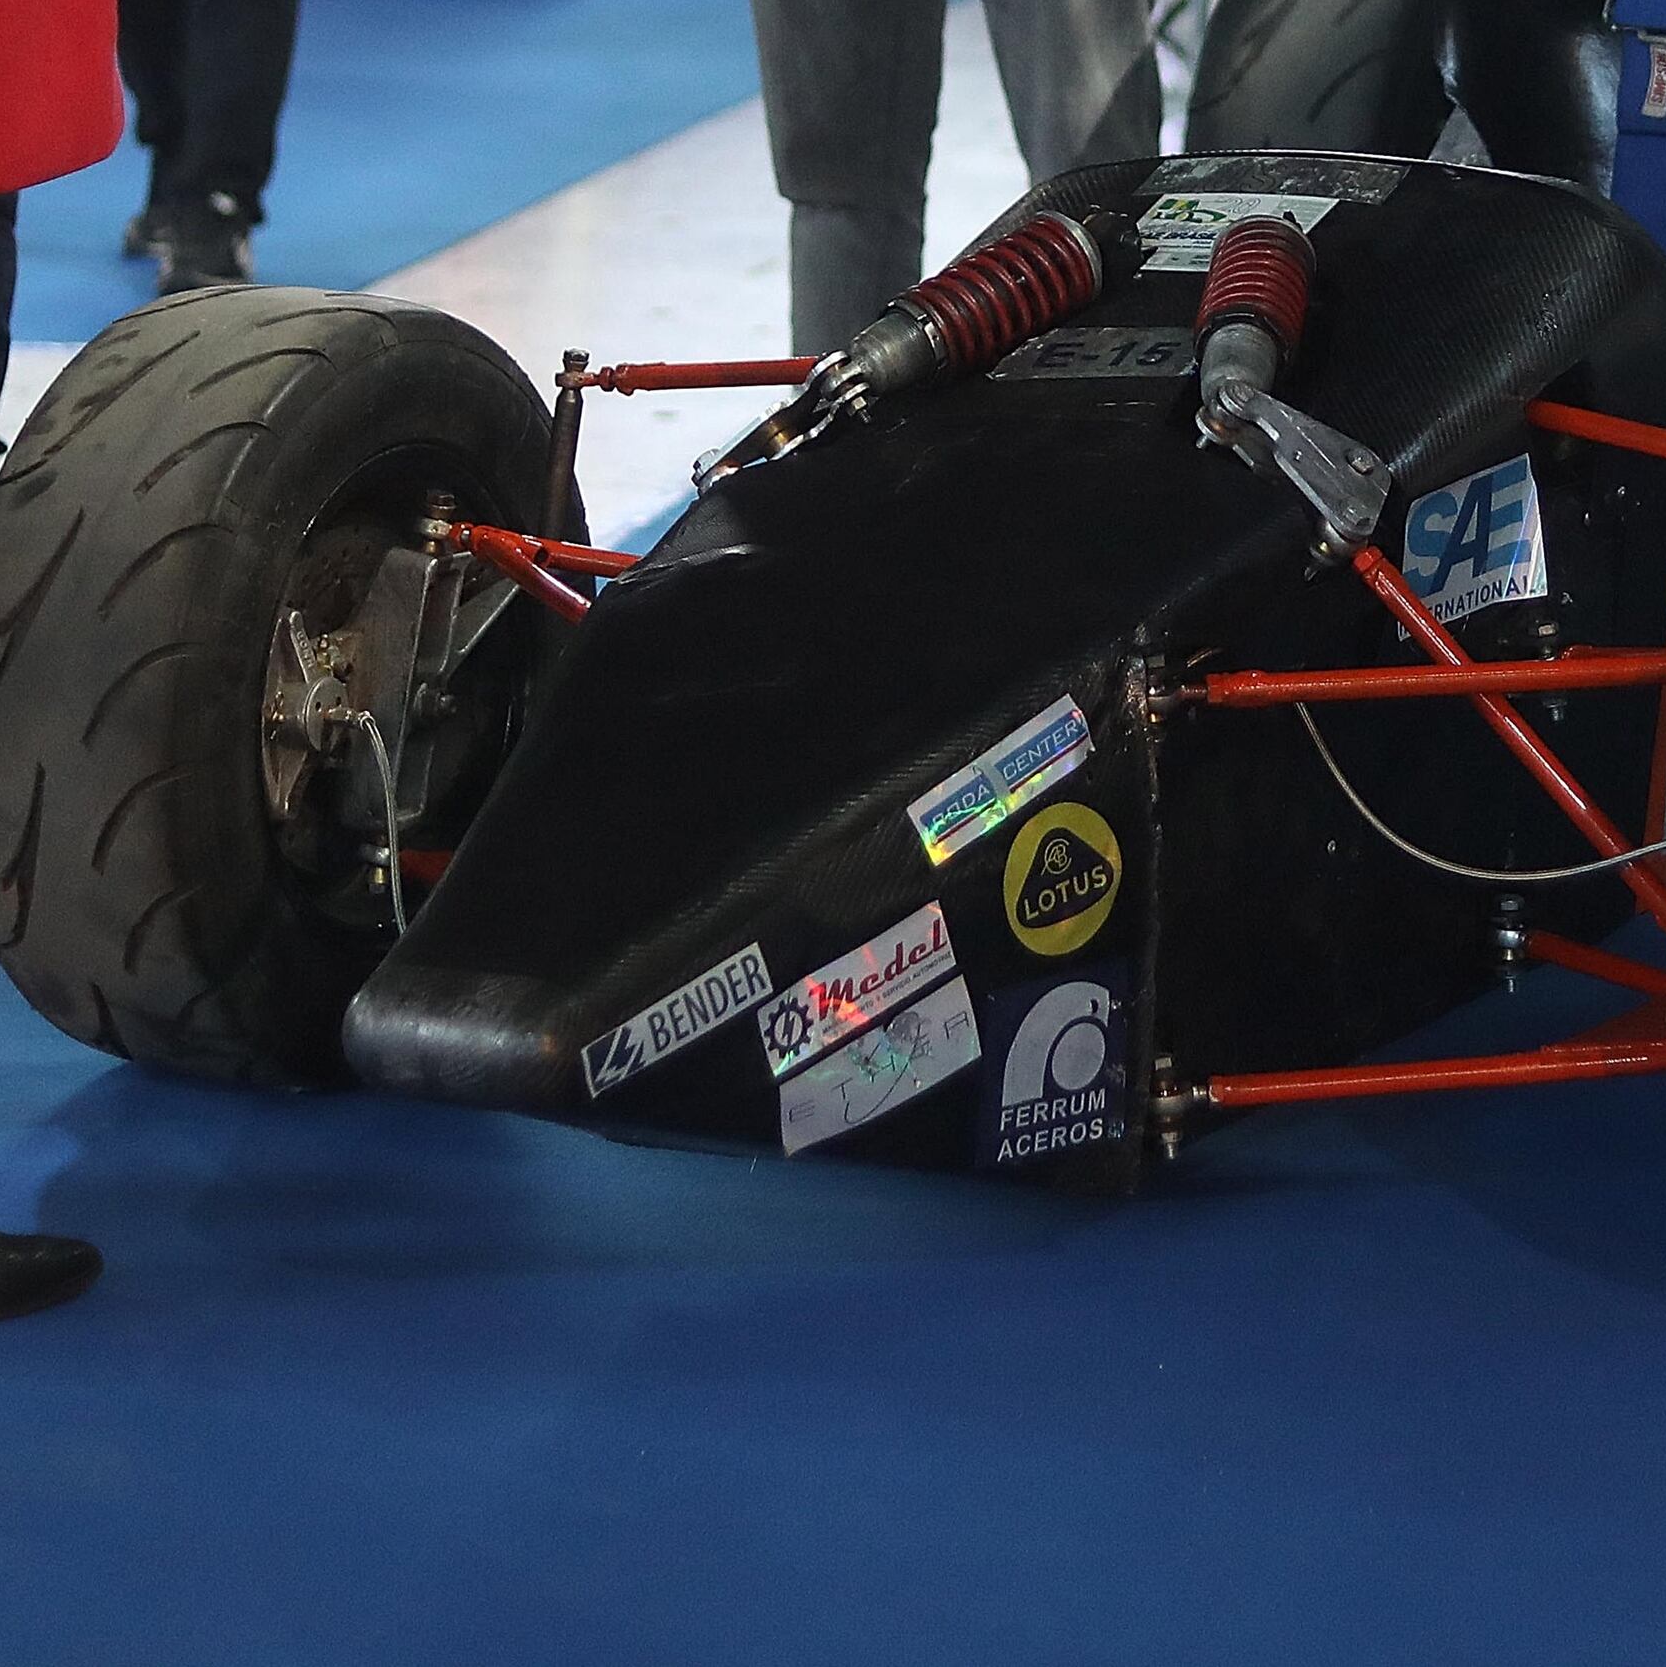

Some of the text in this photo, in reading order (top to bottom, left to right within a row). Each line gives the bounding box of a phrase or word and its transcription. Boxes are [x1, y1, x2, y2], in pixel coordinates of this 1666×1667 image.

[1034, 340, 1182, 368] E-15
[1403, 458, 1532, 599] SAE
[1001, 718, 1080, 781] CENTER
[1024, 864, 1108, 921] LOTUS
[808, 916, 949, 1022] Medel
[647, 953, 767, 1054] BENDER
[1000, 1087, 1106, 1132] FERRUM
[997, 1118, 1104, 1163] ACEROS
